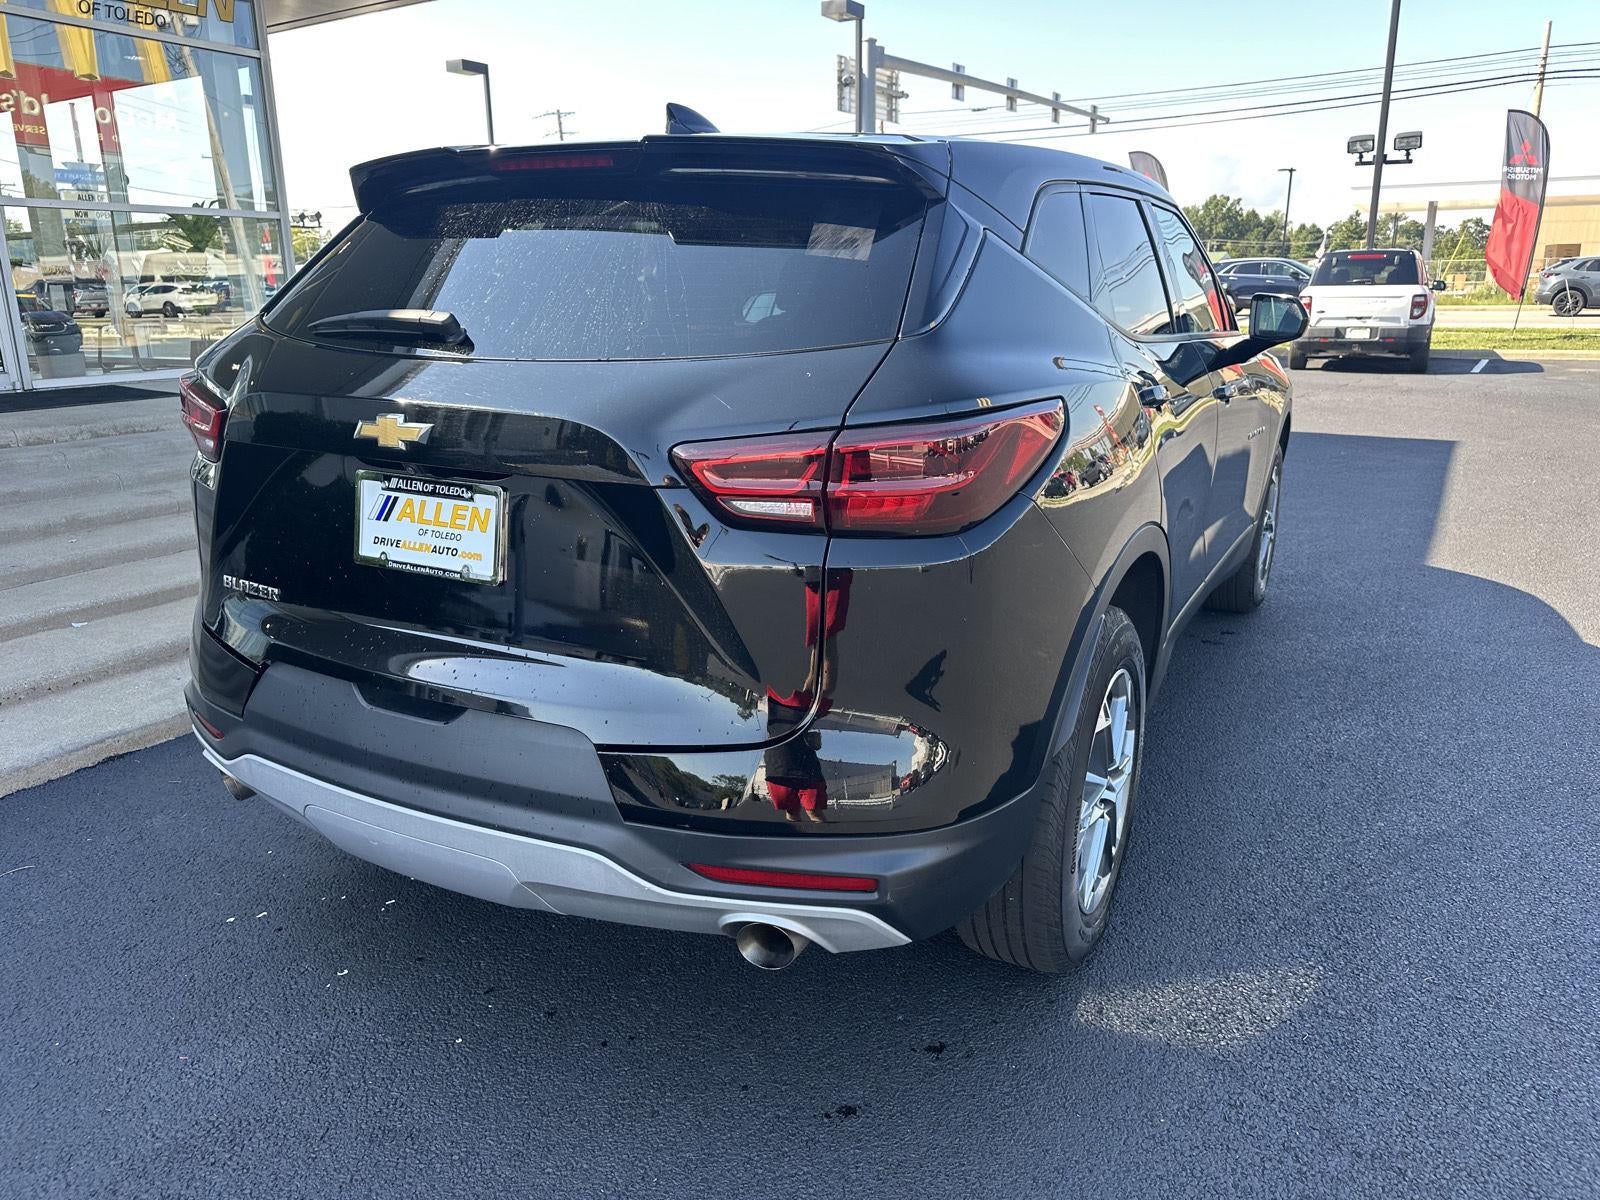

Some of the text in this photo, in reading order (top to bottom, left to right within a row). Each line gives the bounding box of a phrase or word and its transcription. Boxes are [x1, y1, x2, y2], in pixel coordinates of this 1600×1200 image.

[79, 0, 101, 16] OF
[105, 5, 167, 28] TOLEDO
[398, 479, 467, 498] ALLEN OF TOLEDO
[396, 497, 491, 533] ALLEN
[418, 528, 462, 542] OF TOLEDO
[223, 574, 279, 601] BLAZER
